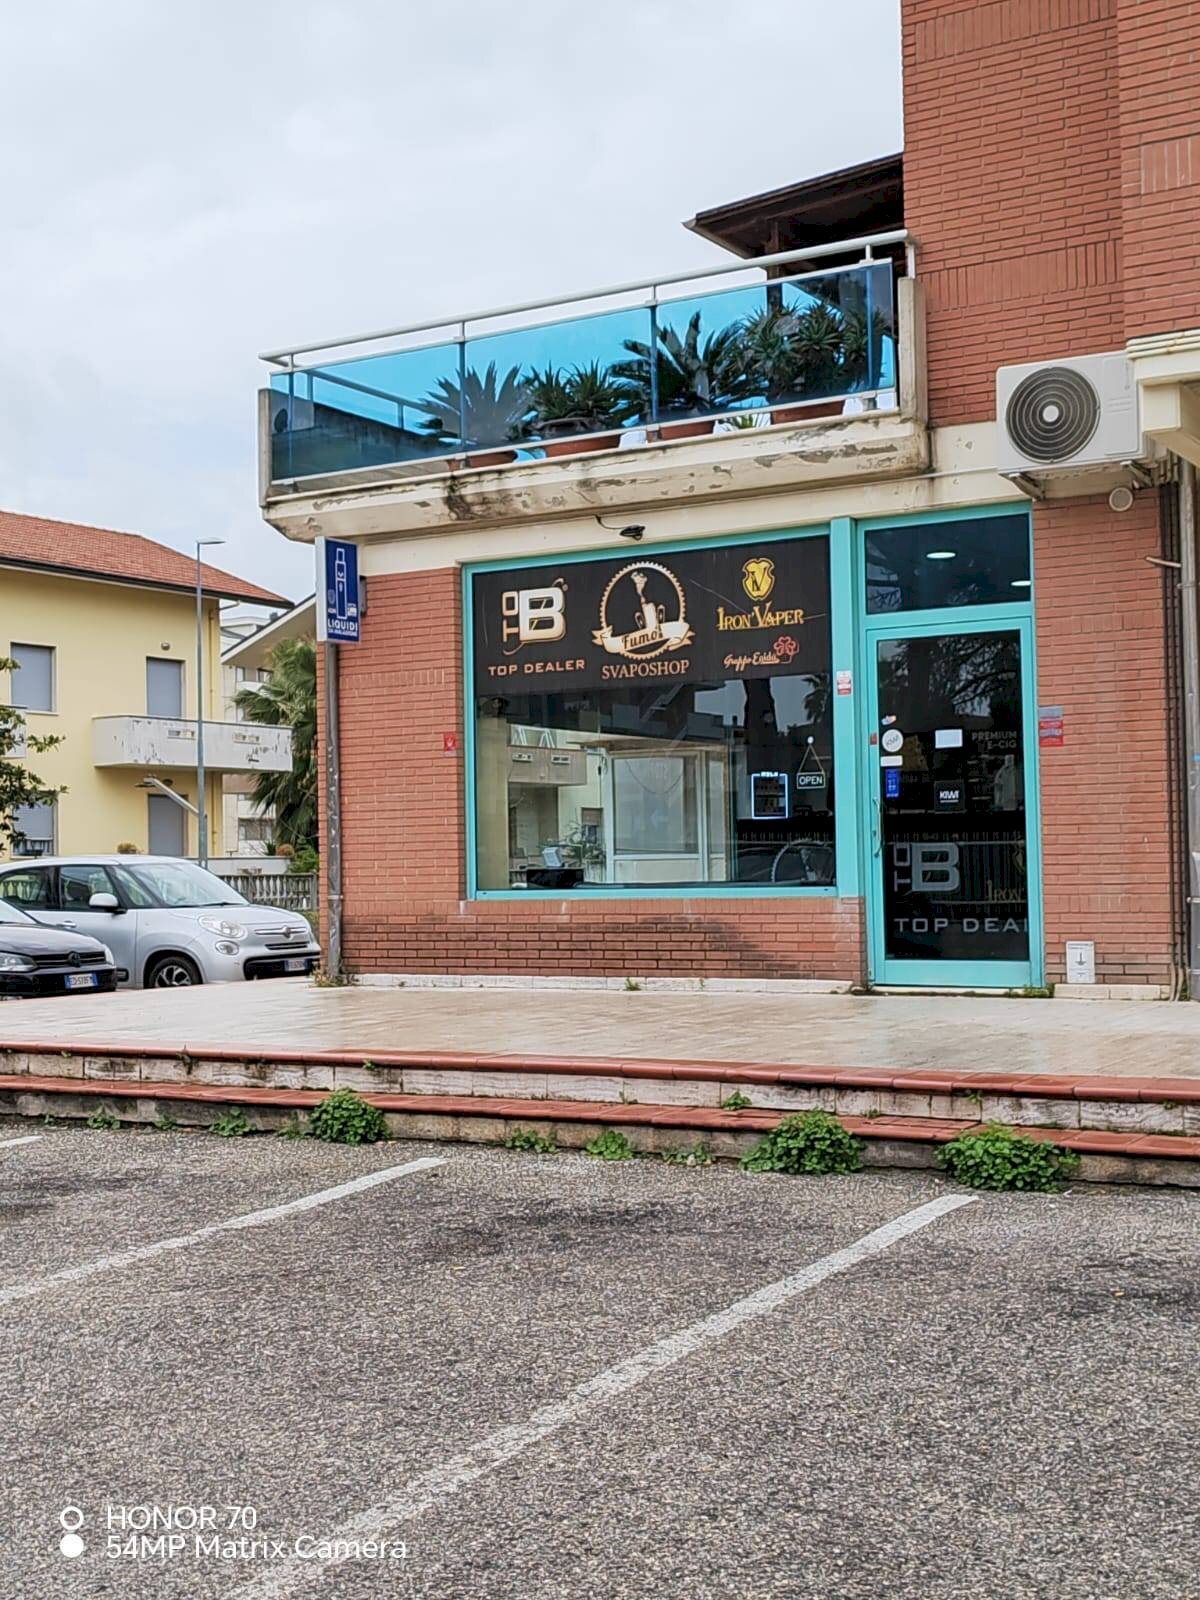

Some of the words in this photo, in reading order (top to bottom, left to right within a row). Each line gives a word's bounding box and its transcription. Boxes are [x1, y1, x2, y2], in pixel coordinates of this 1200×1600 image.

[753, 601, 804, 628] VAPER
[328, 619, 357, 631] LIQUIDI
[488, 664, 518, 676] TOP
[524, 659, 585, 674] DEALER
[602, 659, 690, 680] SVAPOSHOP
[972, 730, 1017, 741] PREMIUM
[799, 775, 823, 786] OPEN
[939, 790, 960, 799] KIWI
[893, 918, 949, 933] TOP
